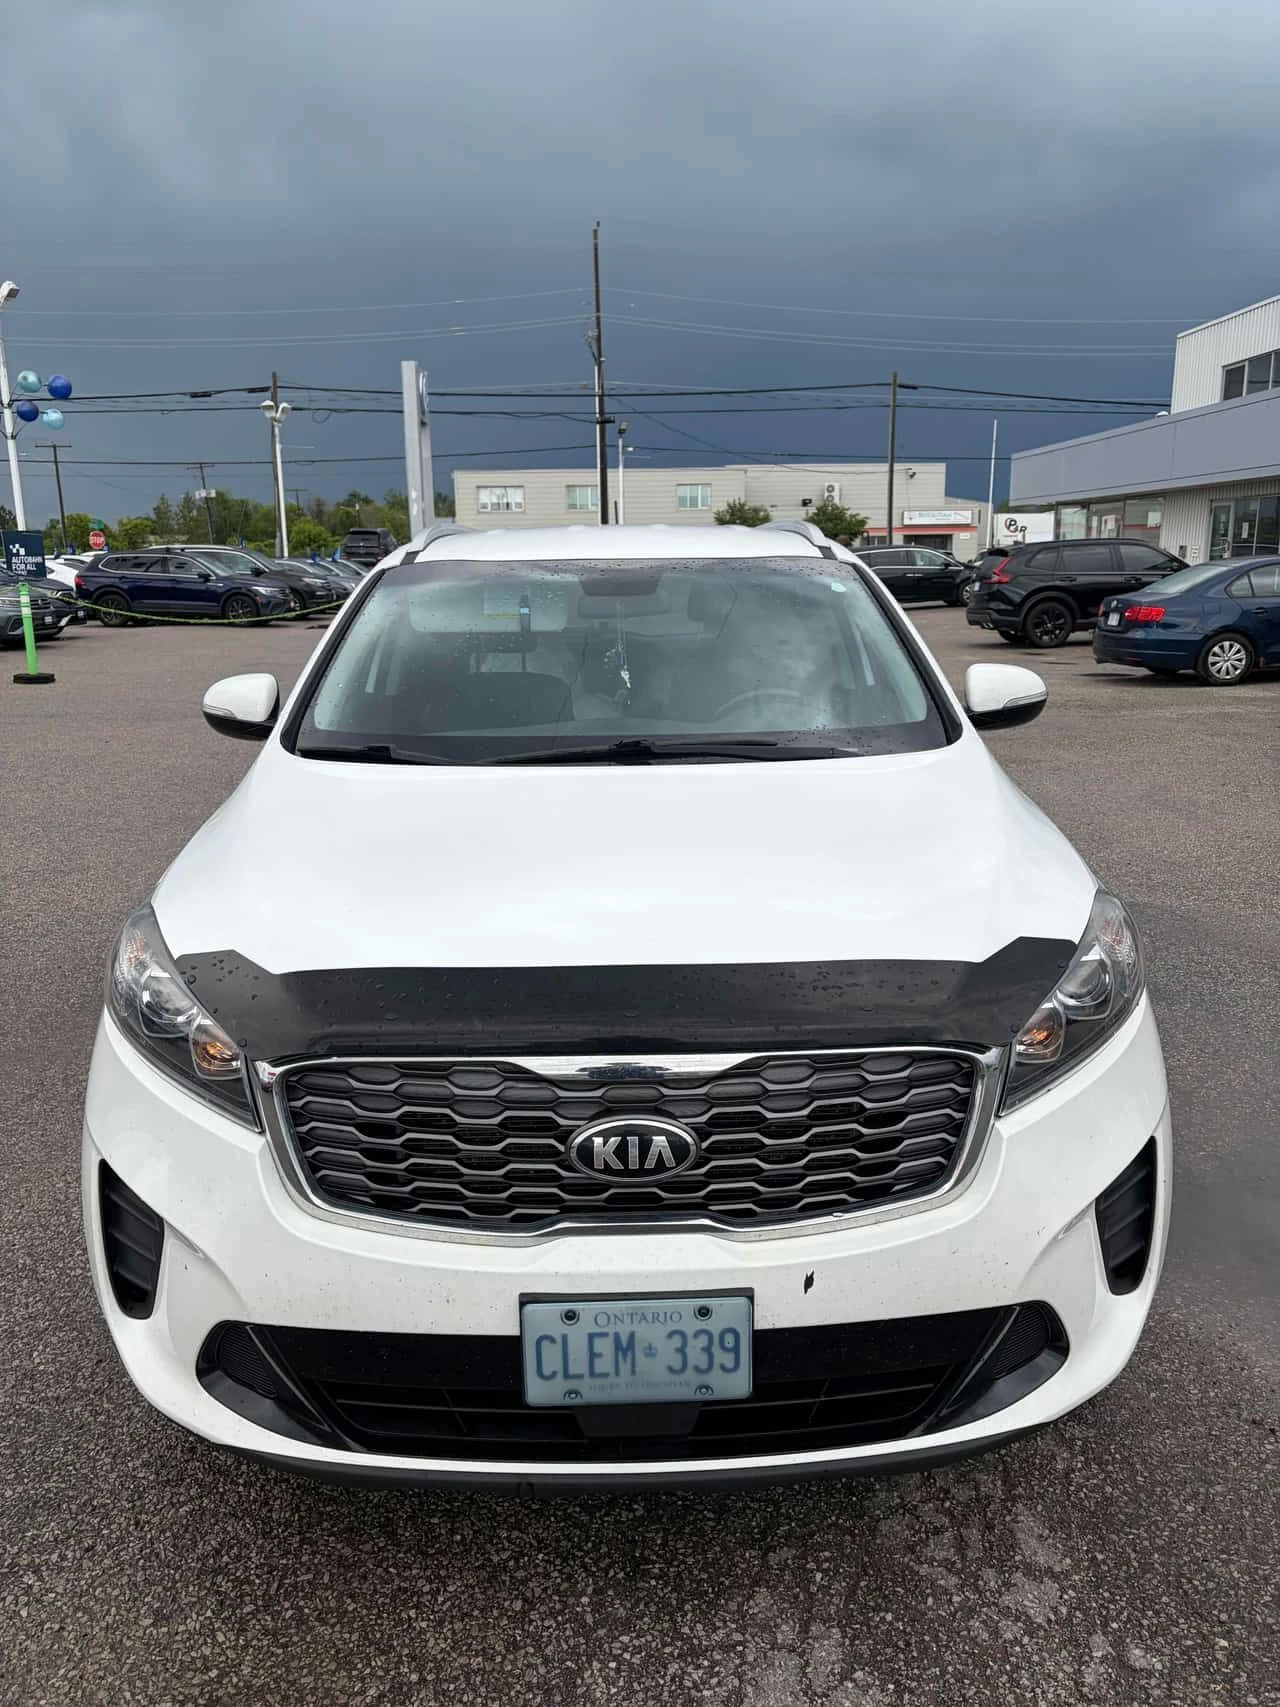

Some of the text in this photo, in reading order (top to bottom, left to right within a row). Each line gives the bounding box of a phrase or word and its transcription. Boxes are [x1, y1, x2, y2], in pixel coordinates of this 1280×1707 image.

[89, 536, 105, 544] STOP
[12, 563, 26, 571] FOR
[592, 1136, 677, 1169] KIA
[594, 1310, 683, 1328] ONTARIO
[535, 1327, 741, 1381] CLEM 339
